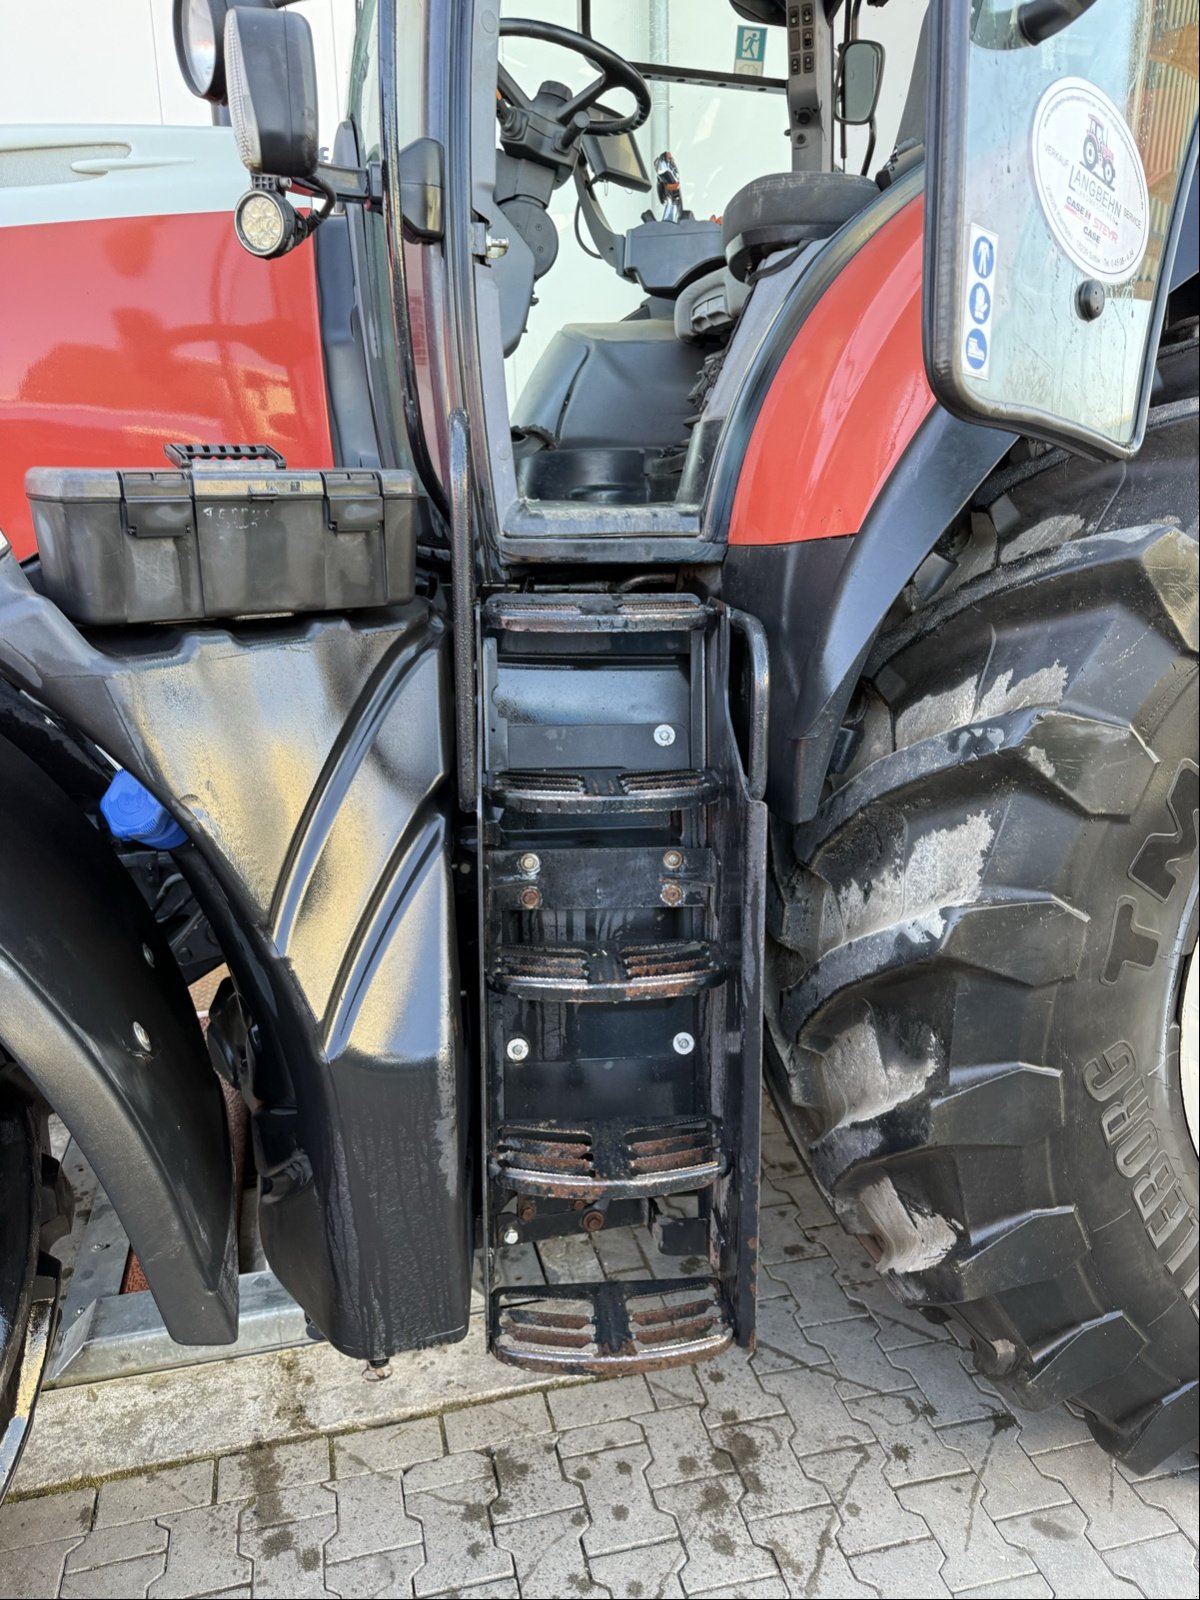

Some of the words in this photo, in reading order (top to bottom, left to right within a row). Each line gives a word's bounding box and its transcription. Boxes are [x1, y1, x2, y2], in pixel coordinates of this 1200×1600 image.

[1044, 142, 1070, 168] VERKAUF
[1068, 164, 1122, 219] LANGBEHN
[1124, 207, 1142, 230] SERVICE
[1065, 195, 1085, 216] CASE
[1092, 217, 1119, 244] STEYR
[1083, 225, 1101, 244] CASE
[1082, 1039, 1199, 1322] LEBORG
